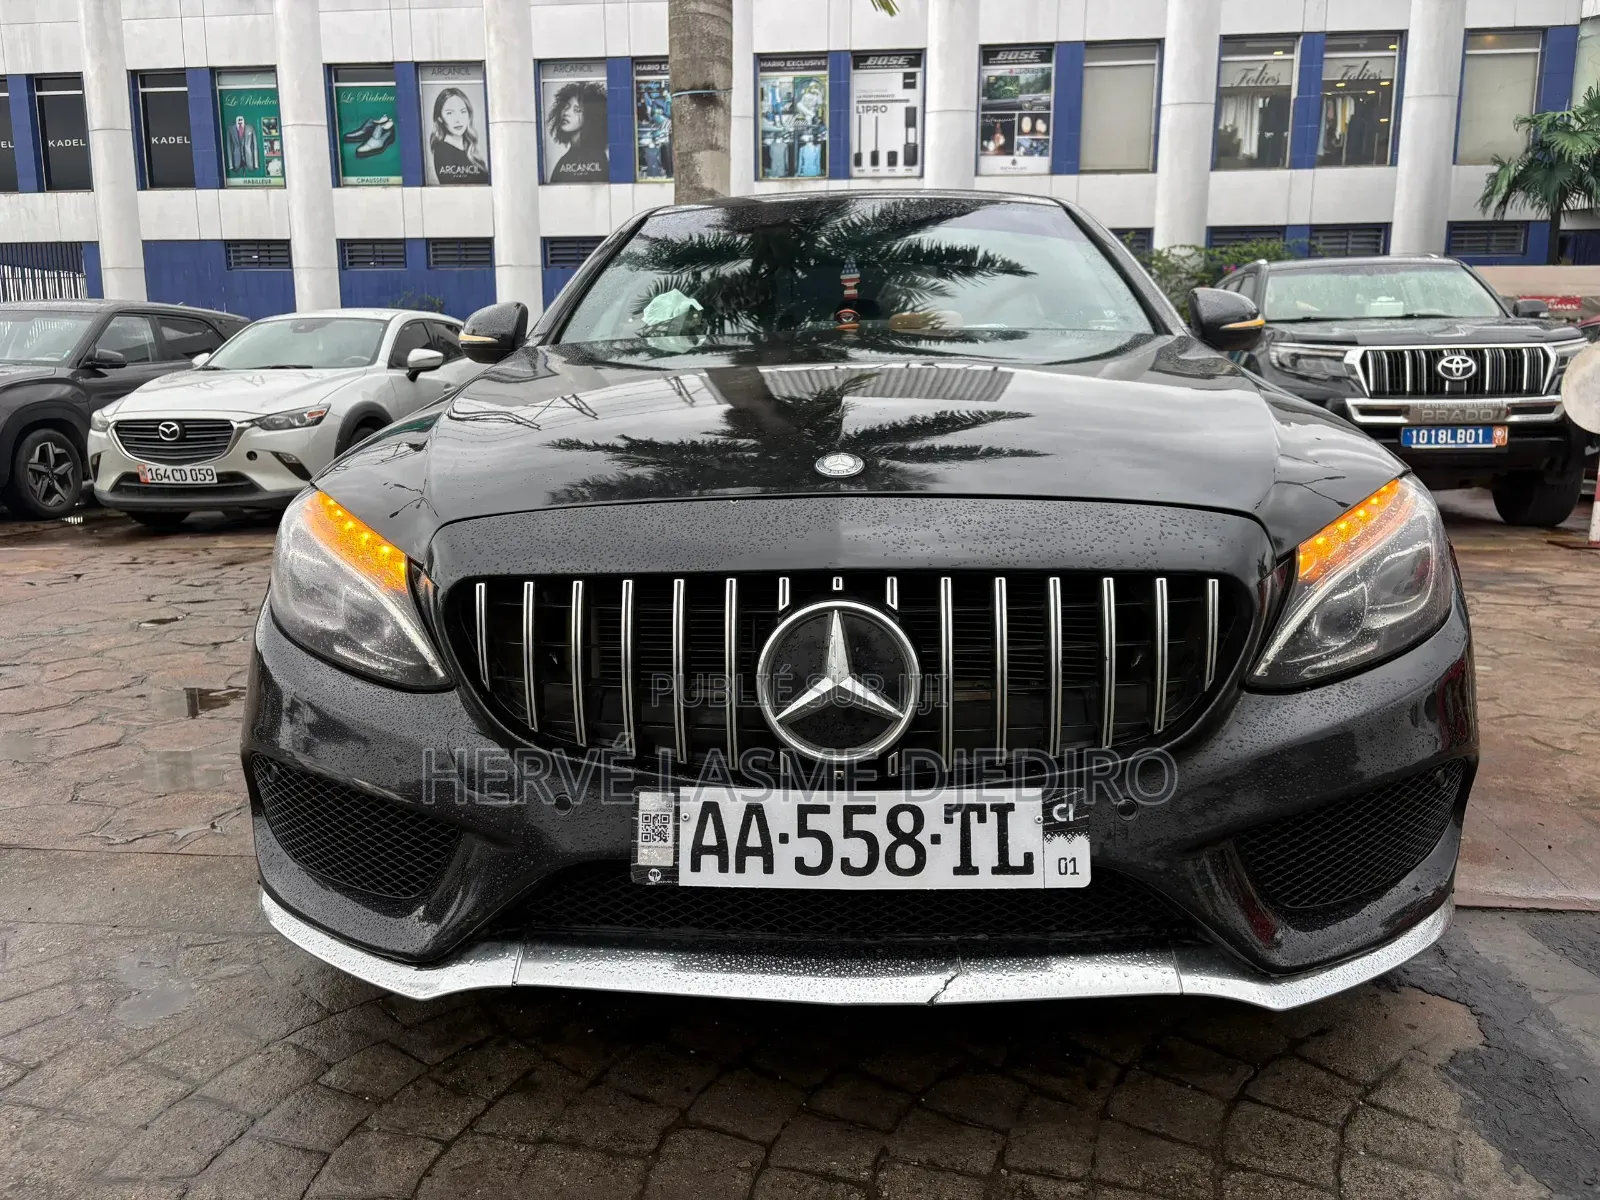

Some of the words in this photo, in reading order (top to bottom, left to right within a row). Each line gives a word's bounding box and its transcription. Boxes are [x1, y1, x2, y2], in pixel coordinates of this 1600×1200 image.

[989, 50, 1047, 60] BOSE
[859, 56, 915, 66] BOSE
[431, 67, 471, 76] ARCANCIL
[224, 95, 237, 106] Le
[240, 95, 278, 105] Richelieu
[341, 91, 354, 103] Le
[356, 91, 395, 102] Richelieu
[48, 139, 86, 147] KADEL
[151, 136, 191, 144] KADEL
[439, 165, 480, 174] ARCANCIL
[559, 162, 602, 172] ARCANCIL
[1421, 409, 1493, 421] PRADO
[1412, 429, 1483, 444] 1018LB01
[148, 468, 171, 481] 164
[171, 468, 188, 482] CD
[190, 468, 215, 482] 059
[1053, 803, 1074, 822] CI
[1058, 857, 1080, 876] 01
